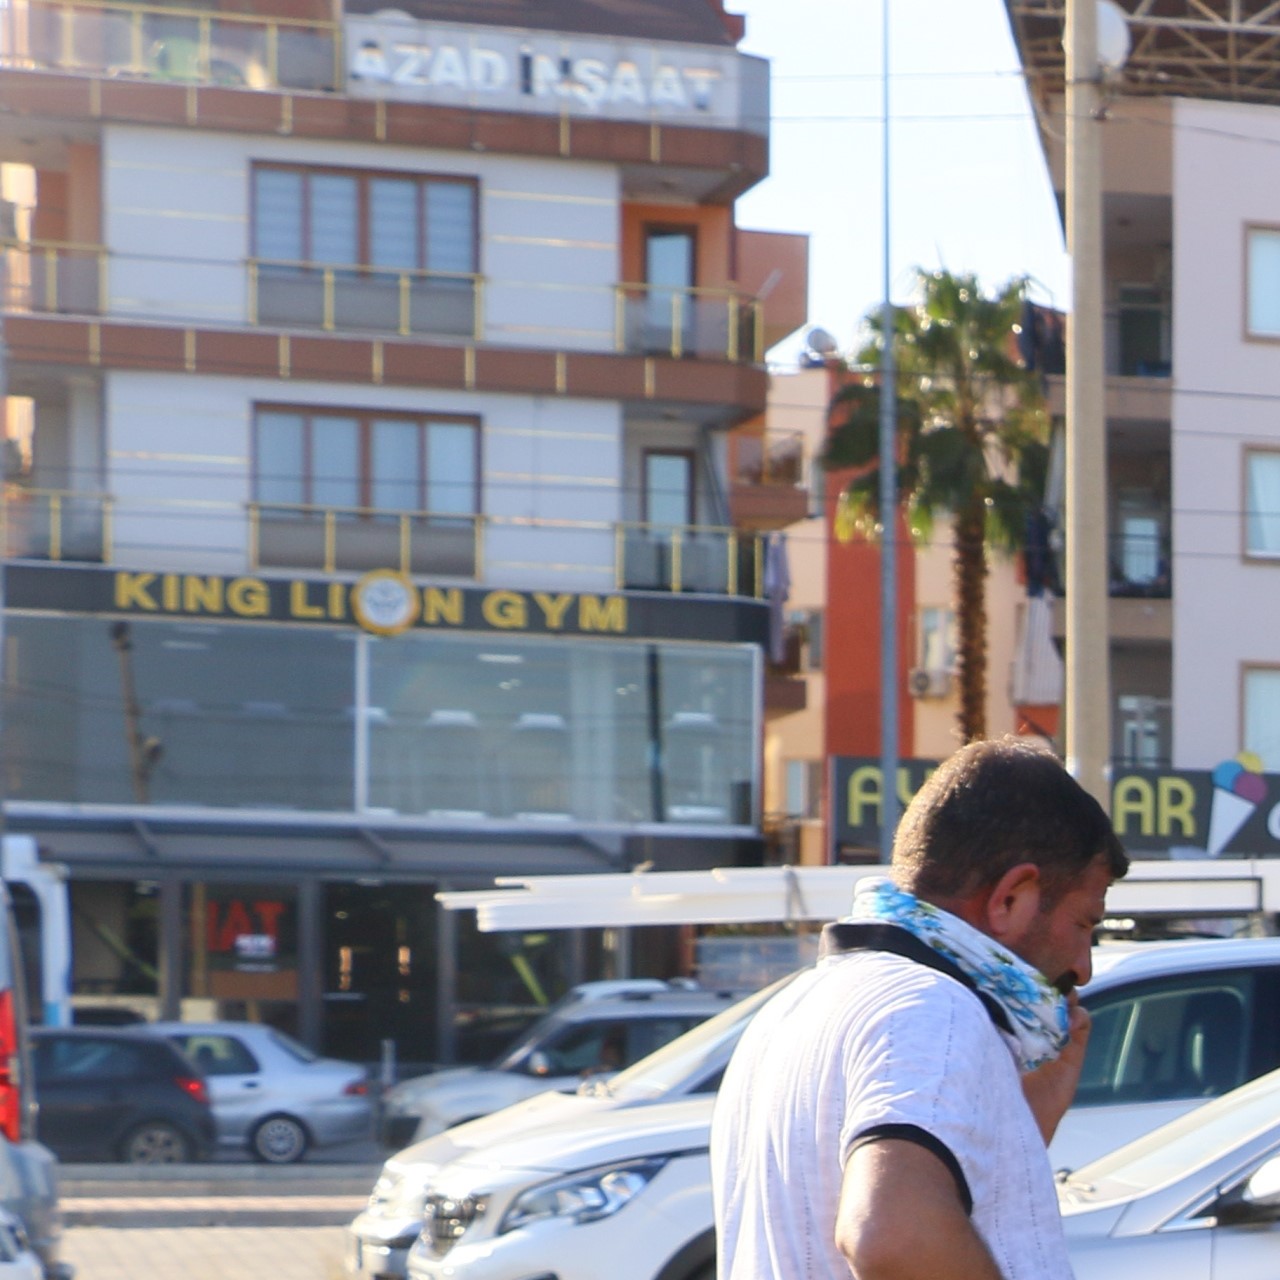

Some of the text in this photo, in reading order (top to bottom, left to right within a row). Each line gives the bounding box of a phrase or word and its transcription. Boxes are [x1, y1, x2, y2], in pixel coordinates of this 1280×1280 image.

[350, 40, 722, 111] AZAD İNŞAAT
[115, 571, 270, 617] KING
[482, 589, 628, 632] GYM
